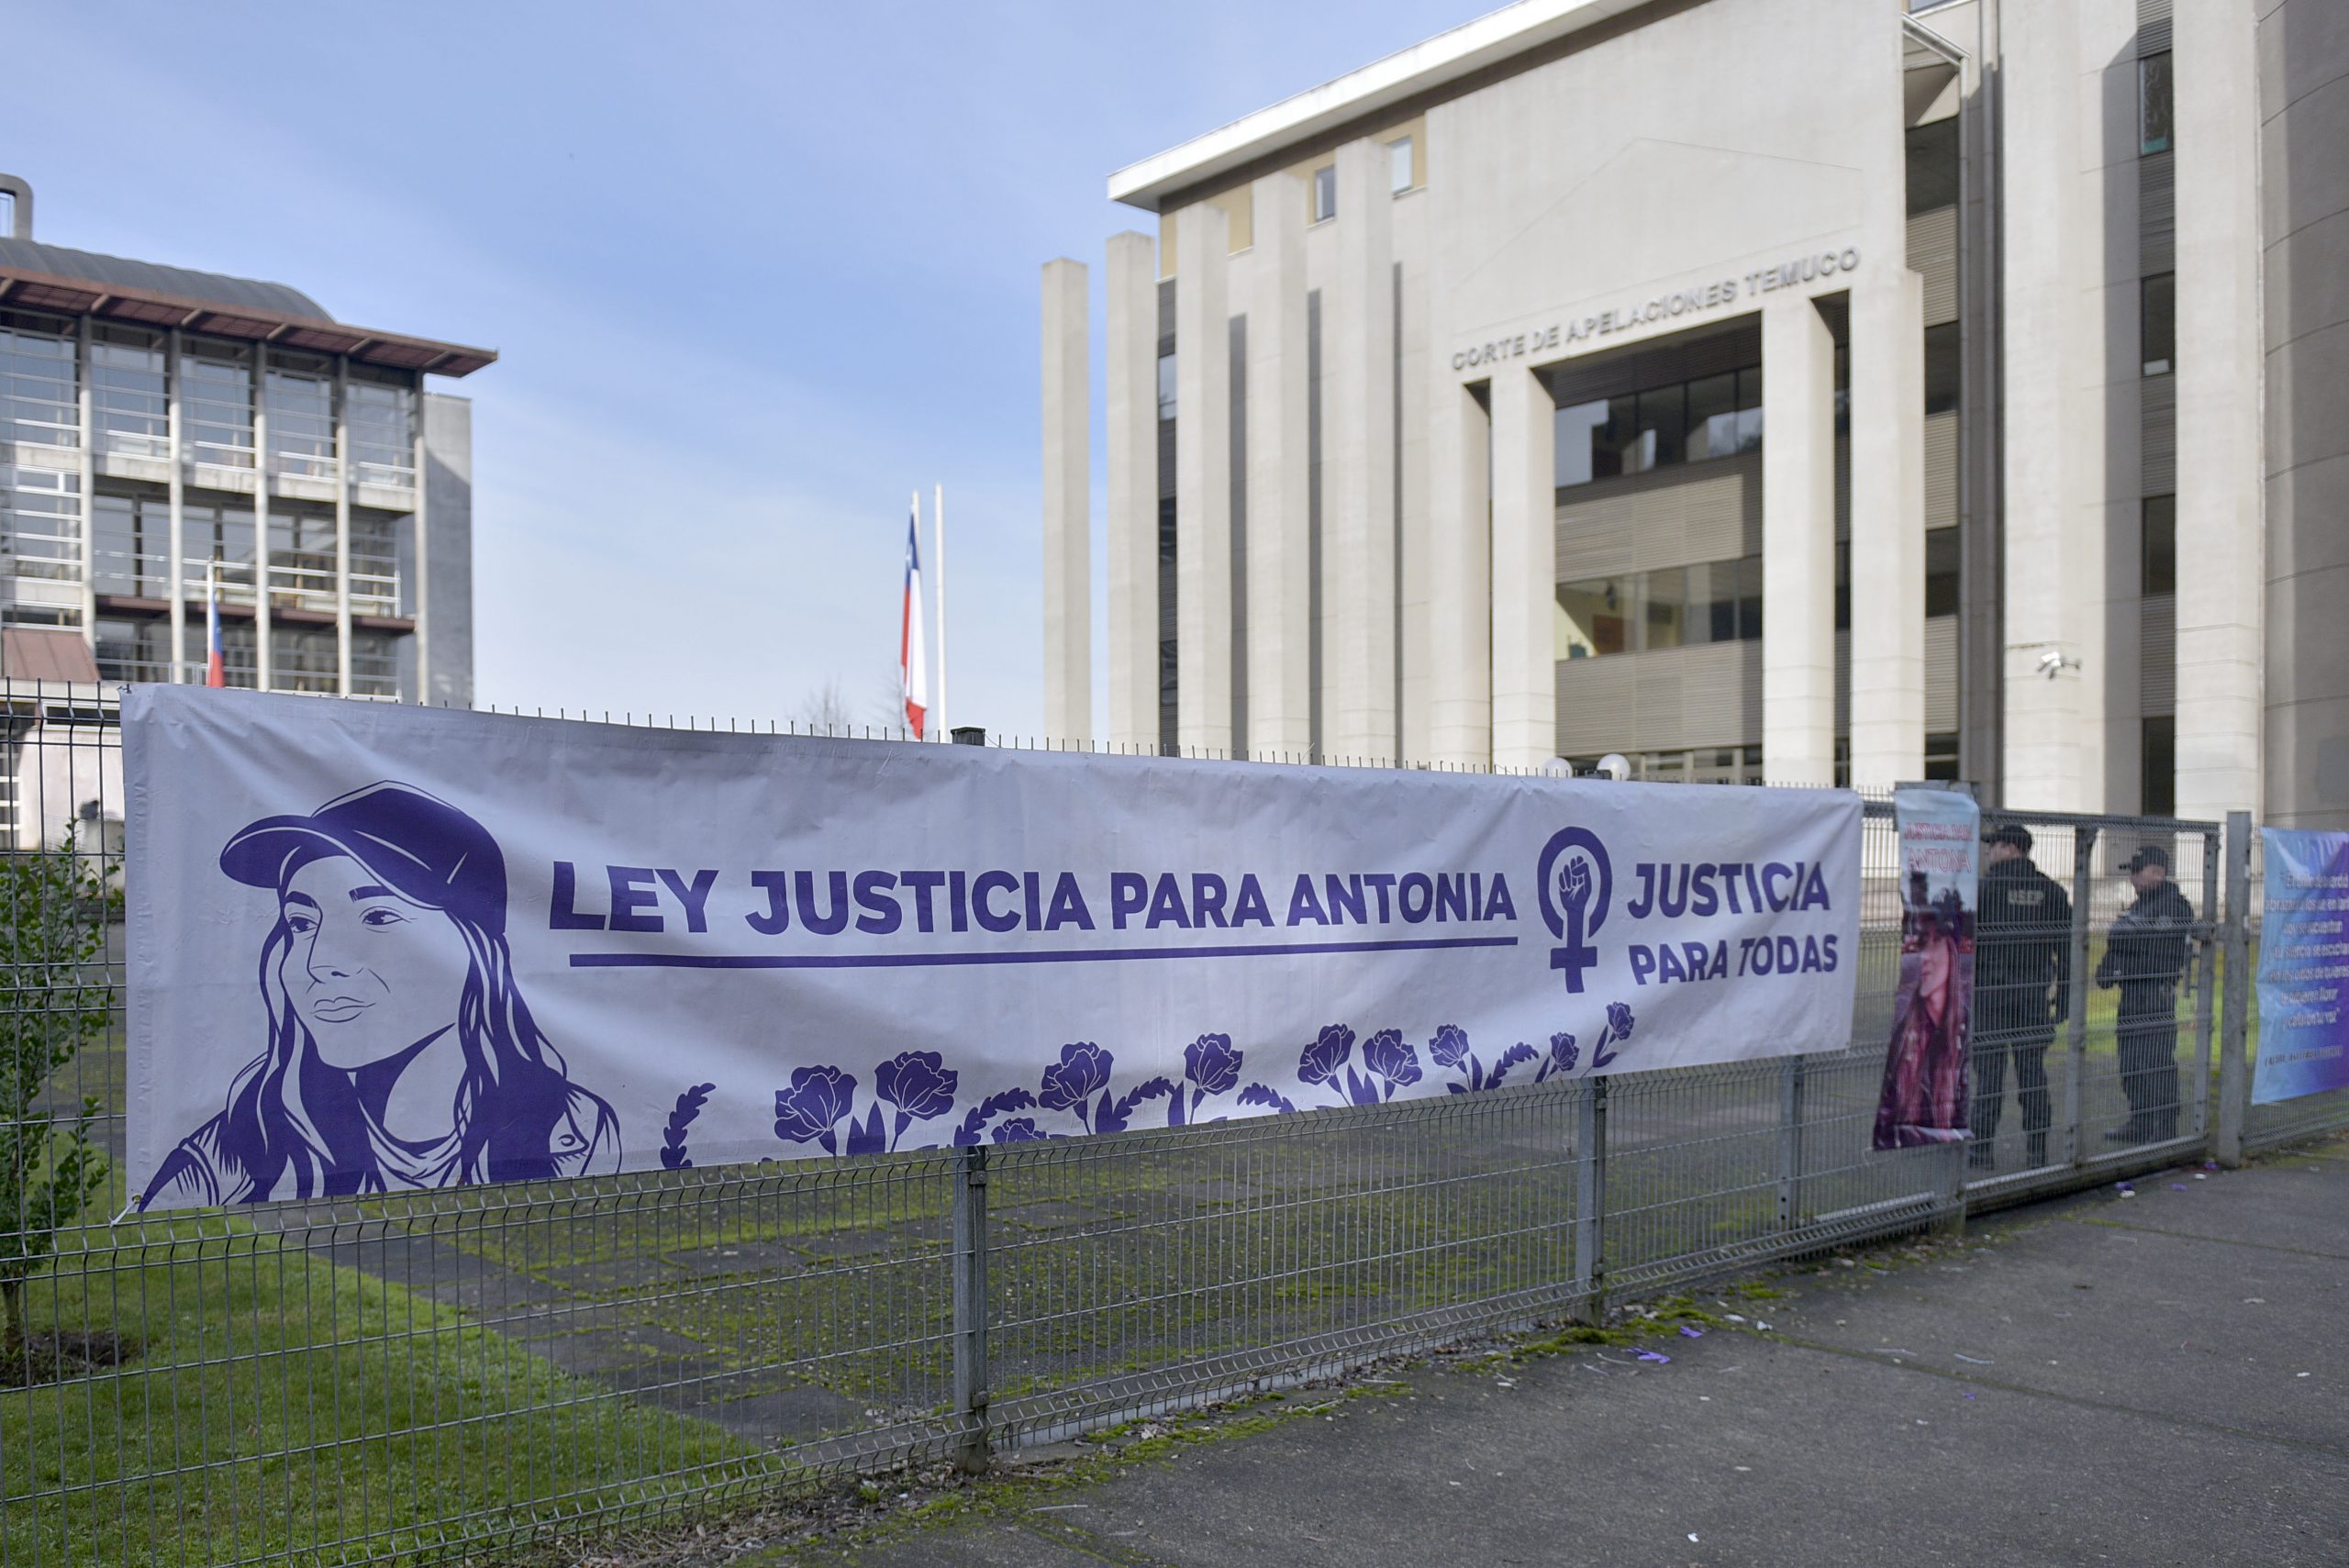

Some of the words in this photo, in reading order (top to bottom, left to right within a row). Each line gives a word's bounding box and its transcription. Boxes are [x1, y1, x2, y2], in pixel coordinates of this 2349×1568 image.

[1453, 334, 1526, 371] CORTE
[1531, 325, 1561, 352] DE
[1565, 279, 1737, 344] APELACIONES
[1745, 247, 1862, 296] TEMUCO
[549, 861, 719, 933] LEY
[744, 869, 1097, 936] JUSTICIA
[1110, 872, 1275, 929] PARA
[1286, 872, 1518, 927] ANTONIA
[1627, 861, 1831, 919] JUSTICIA
[1628, 939, 1728, 985] PARA
[1738, 933, 1839, 977] TODAS
